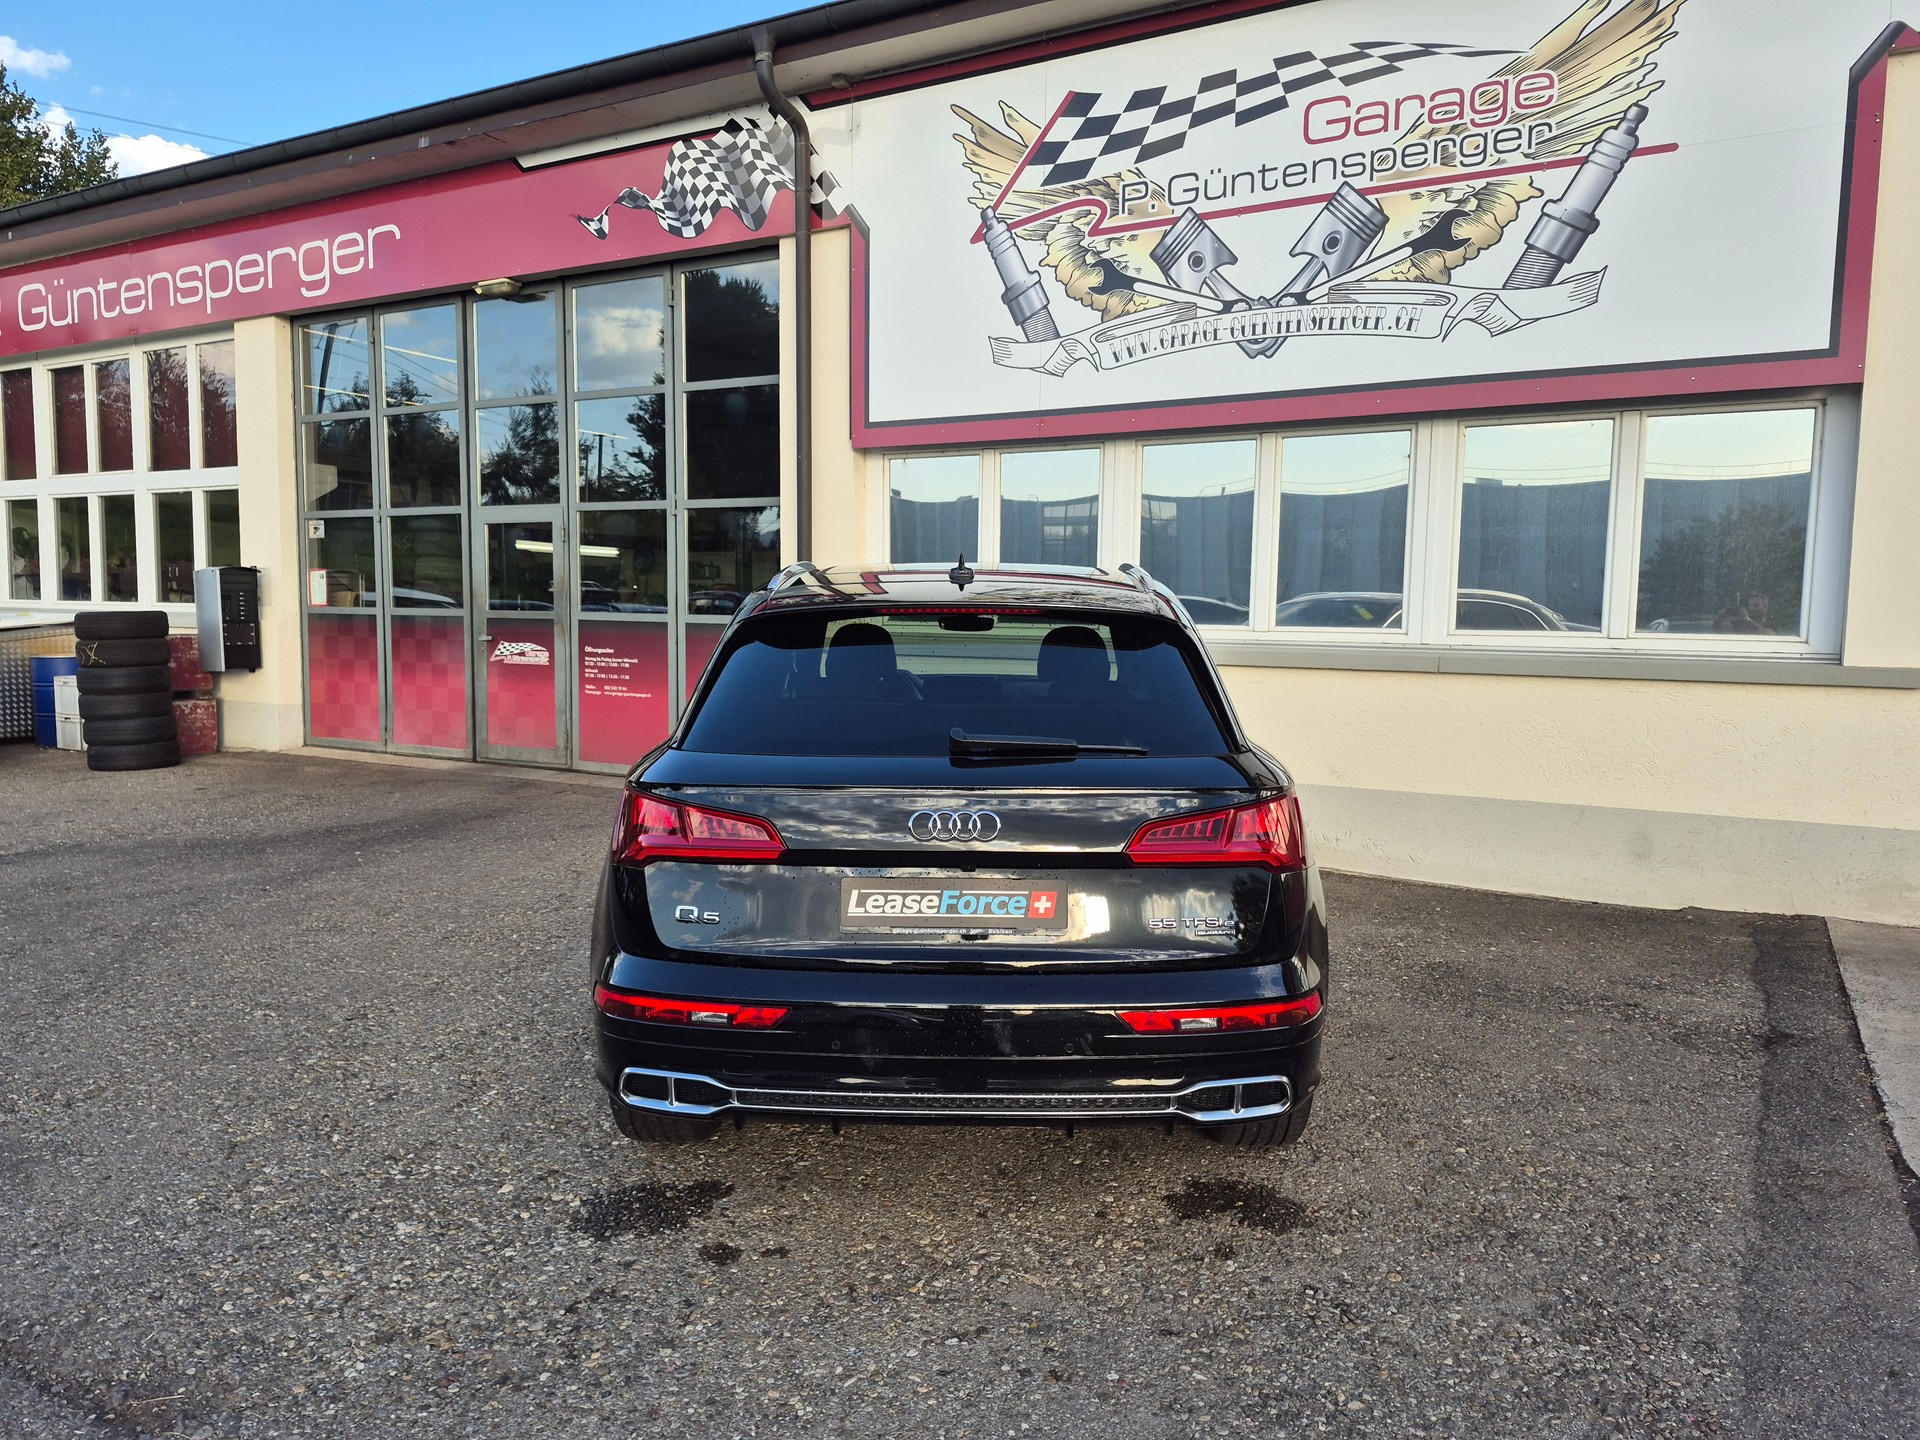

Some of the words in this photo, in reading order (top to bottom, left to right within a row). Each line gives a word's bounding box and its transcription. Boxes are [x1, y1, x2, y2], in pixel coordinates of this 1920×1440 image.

[1303, 71, 1556, 146] Garage
[1119, 184, 1157, 215] P.
[1167, 119, 1555, 208] Güntensperger
[17, 223, 401, 332] Güntensperger
[1110, 306, 1423, 363] WWW.GARAGE-GUENTENSPERGER.CH
[675, 905, 720, 924] Q5
[847, 889, 1027, 915] LeaseForce
[1148, 918, 1177, 929] 55
